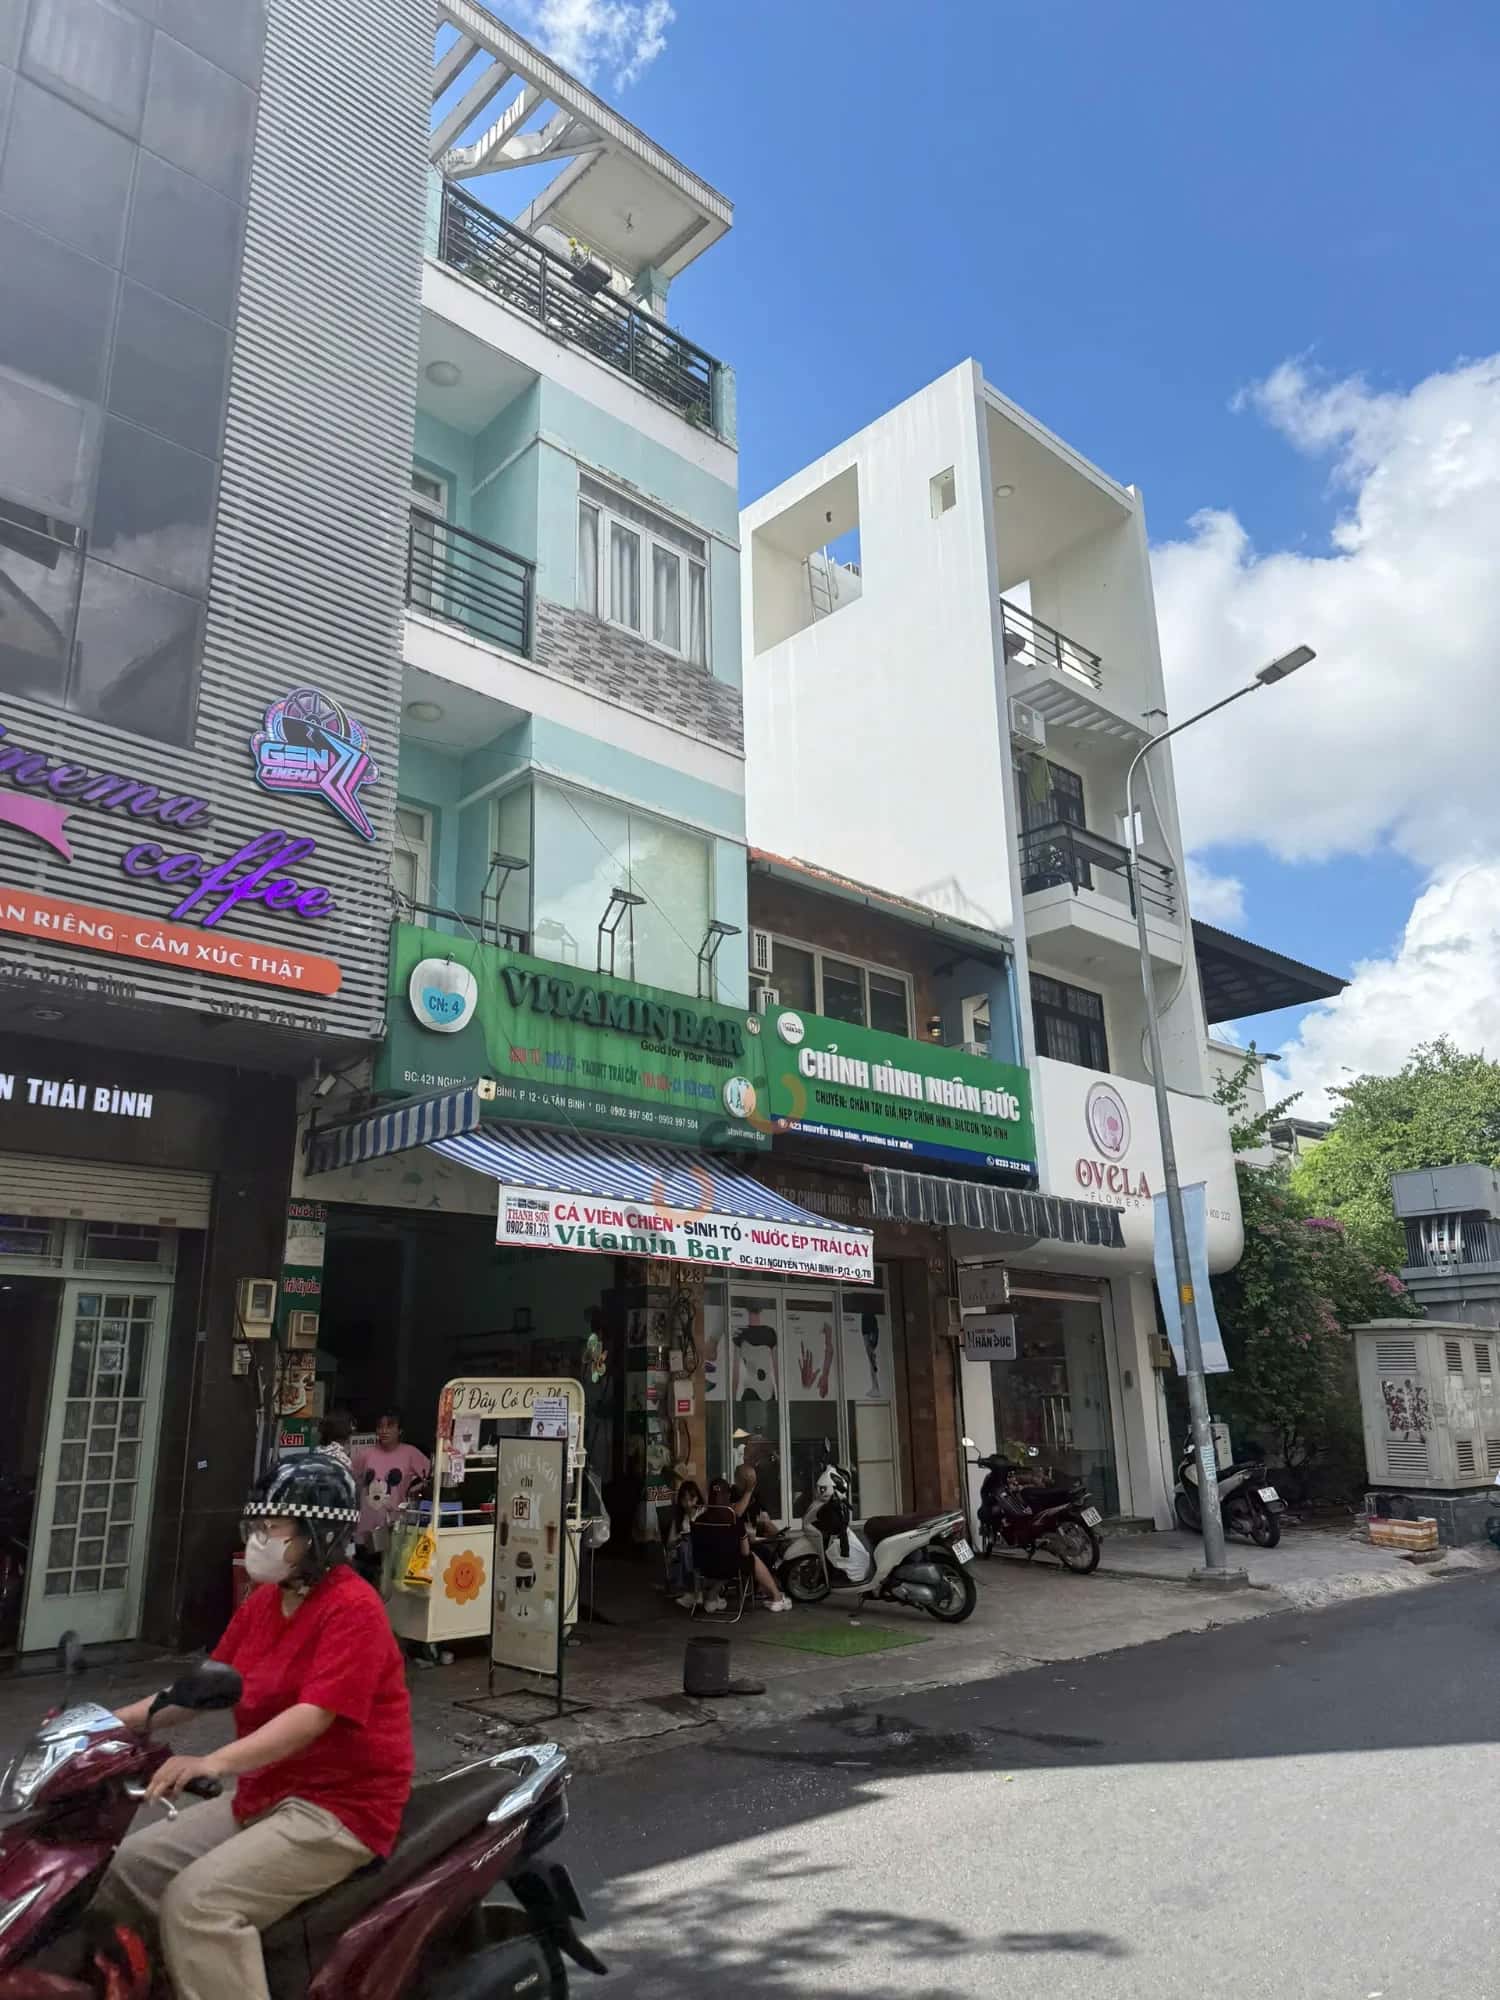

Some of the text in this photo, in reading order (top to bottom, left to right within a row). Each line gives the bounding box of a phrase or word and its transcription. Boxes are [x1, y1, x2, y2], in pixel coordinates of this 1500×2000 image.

[261, 767, 317, 782] CINEMA
[121, 829, 337, 926] coffee
[33, 910, 114, 940] RIÊNG
[135, 931, 190, 956] CẢM
[196, 946, 243, 967] XÚC
[248, 956, 304, 980] THẬT
[428, 995, 459, 1014] CN: 4
[503, 967, 745, 1060] VITAMIN BAR
[641, 1040, 733, 1070] Good for your health
[798, 1043, 1020, 1121] CHỈNH HÌNH NHÂN ĐỨC
[27, 1078, 87, 1110] THÁI
[93, 1084, 153, 1118] BÌNH
[567, 1097, 585, 1110] BÌNH
[871, 1102, 883, 1116] TAY
[507, 1208, 550, 1224] THANH SƠN
[554, 1201, 580, 1222] CÁ
[583, 1206, 624, 1228] VIÊN
[683, 1220, 718, 1239] SINH
[720, 1221, 741, 1241] TỐ
[752, 1228, 790, 1248] NƯỚC
[792, 1231, 808, 1250] ÉP
[809, 1237, 843, 1254] TRÁI
[845, 1241, 869, 1258] CÂY
[554, 1223, 732, 1261] Vitamin Bar
[740, 1254, 753, 1265] ĐC:
[754, 1255, 767, 1266] 421
[469, 1386, 496, 1414] Đây
[501, 1387, 520, 1409] Có
[280, 1432, 305, 1447] Kem
